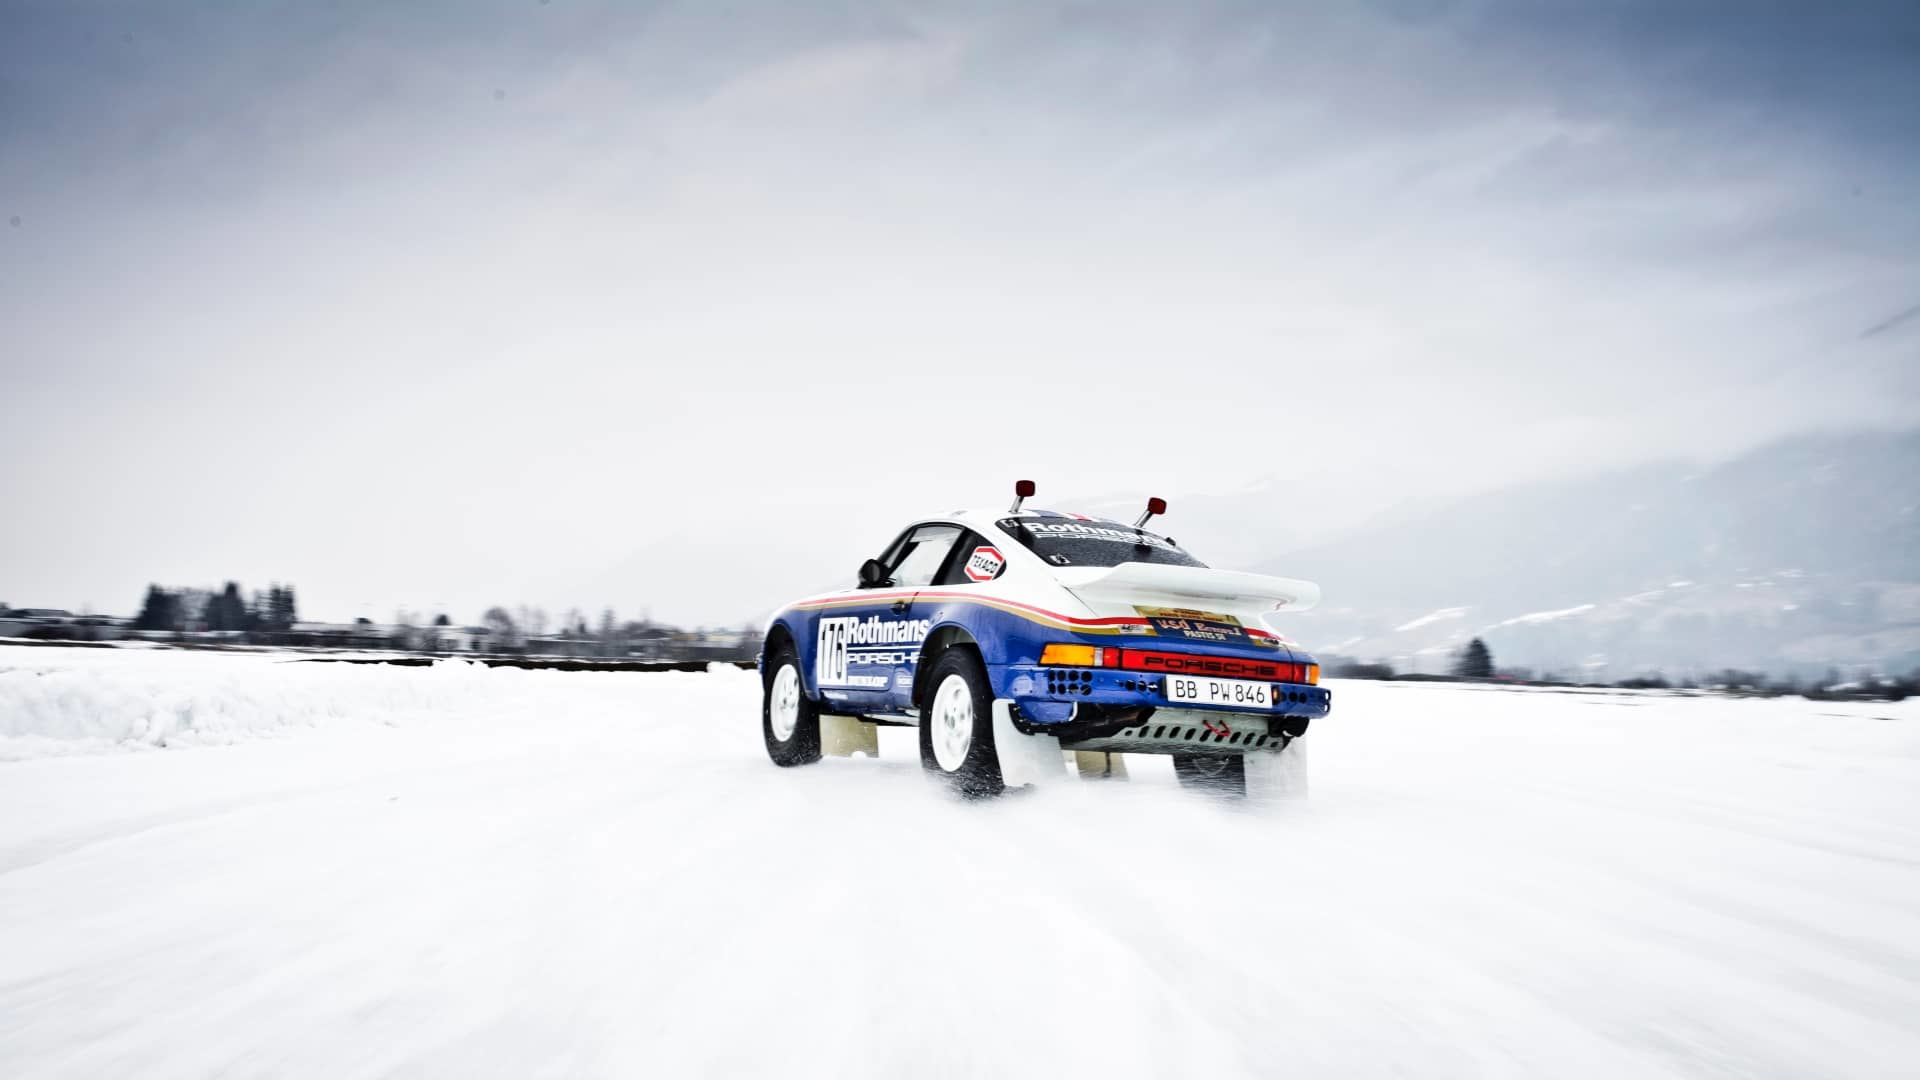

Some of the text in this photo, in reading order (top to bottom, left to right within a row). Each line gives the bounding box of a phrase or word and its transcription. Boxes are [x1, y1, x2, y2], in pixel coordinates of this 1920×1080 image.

[973, 554, 998, 574] TEXACO
[847, 615, 929, 644] Rothmans
[821, 623, 844, 680] 176
[1145, 656, 1277, 675] PORSCHE
[1175, 680, 1265, 704] BB PW 846
